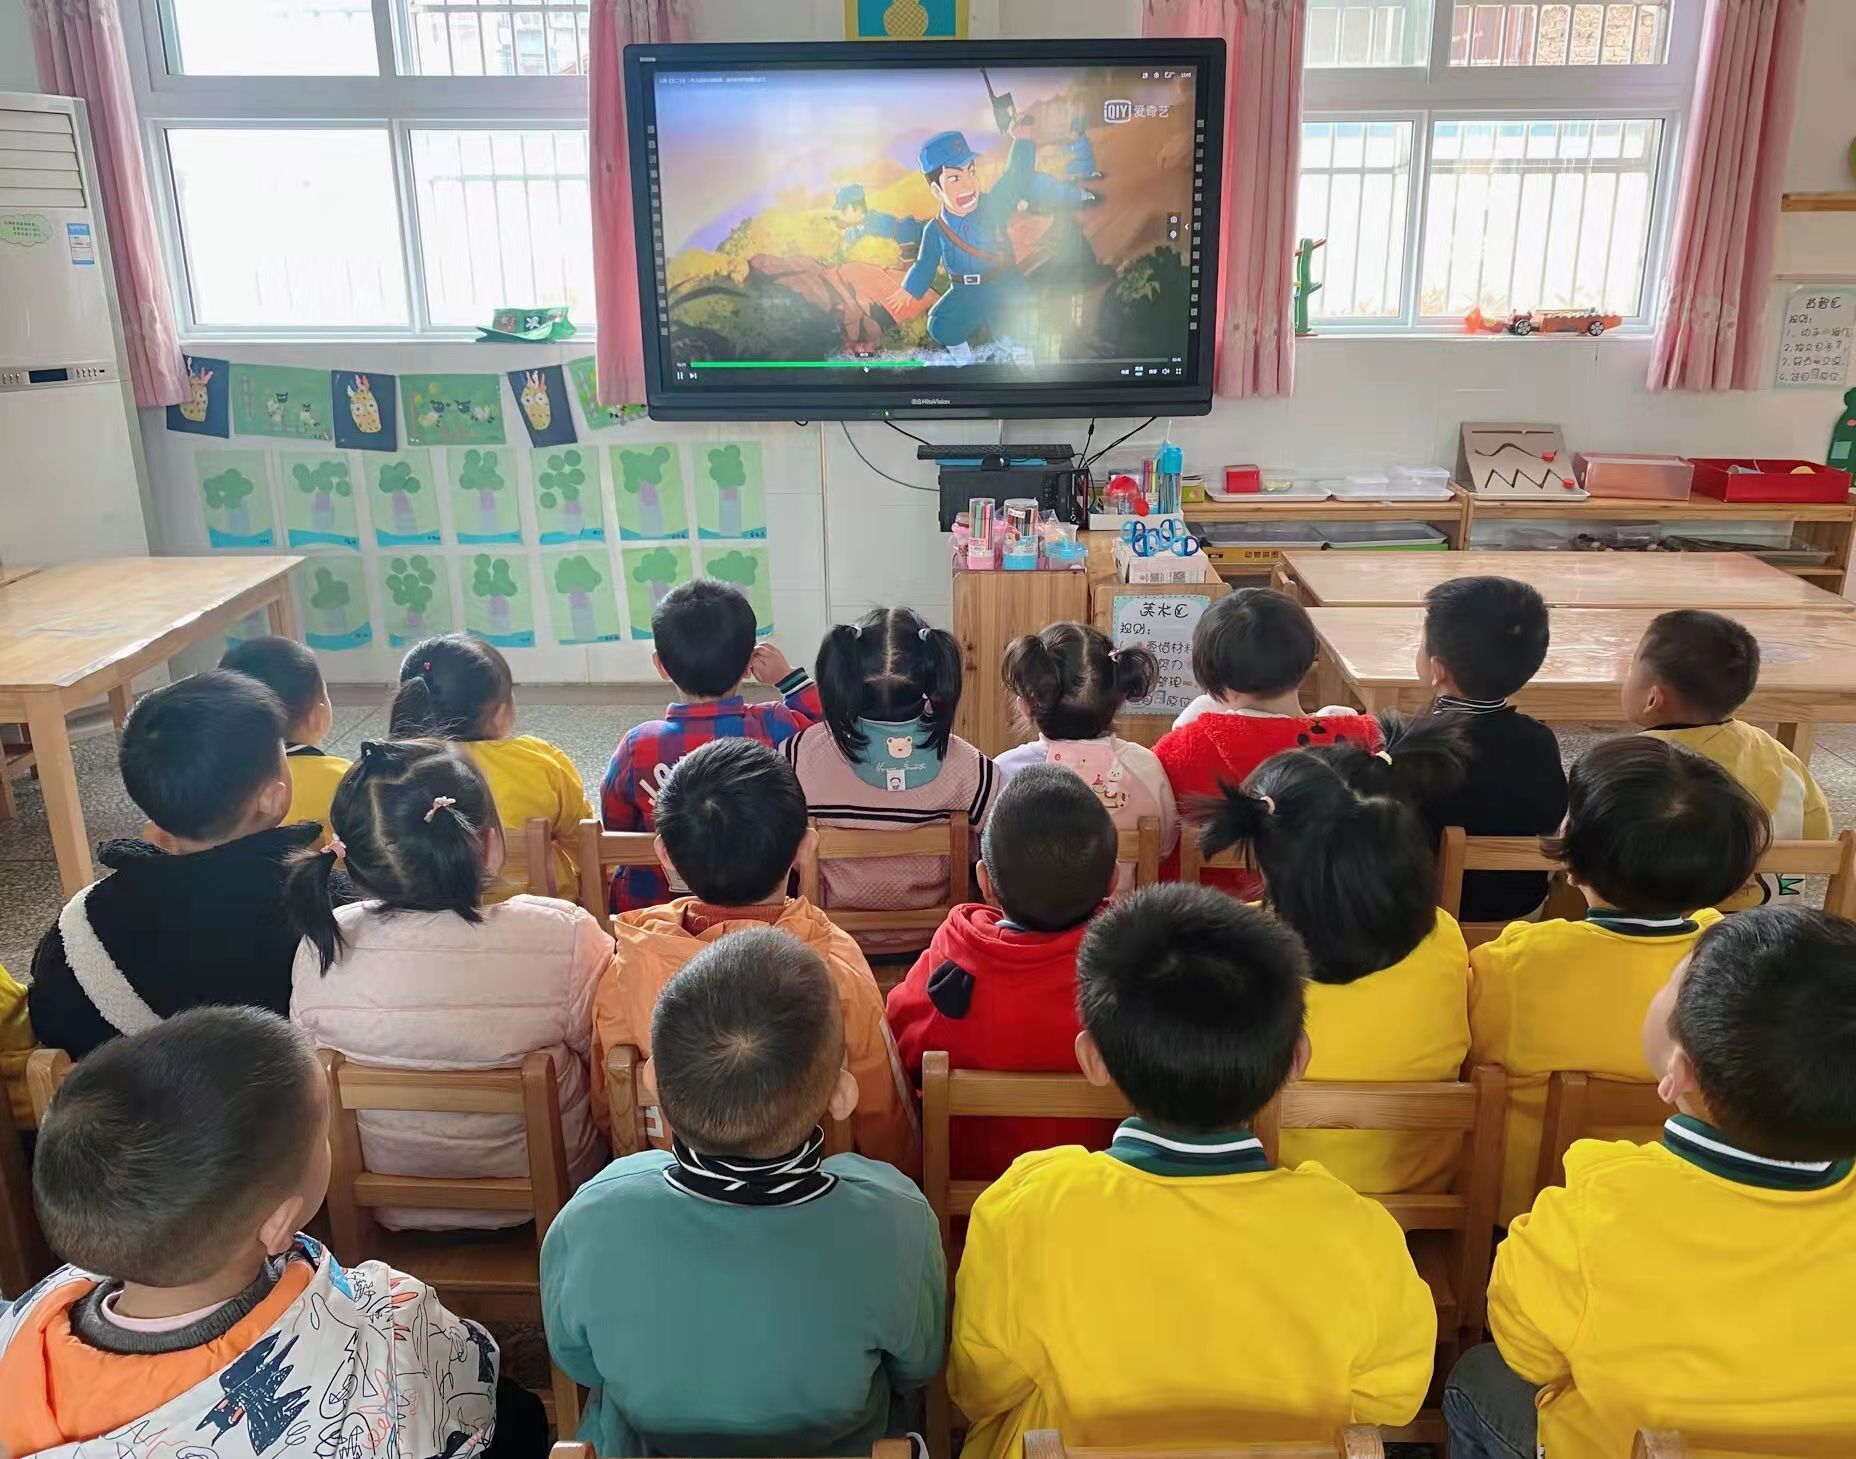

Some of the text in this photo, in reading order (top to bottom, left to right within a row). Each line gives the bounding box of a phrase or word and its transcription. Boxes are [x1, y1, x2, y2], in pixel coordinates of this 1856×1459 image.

[1133, 105, 1169, 118] 爱奇艺
[1139, 601, 1190, 618] 美术区
